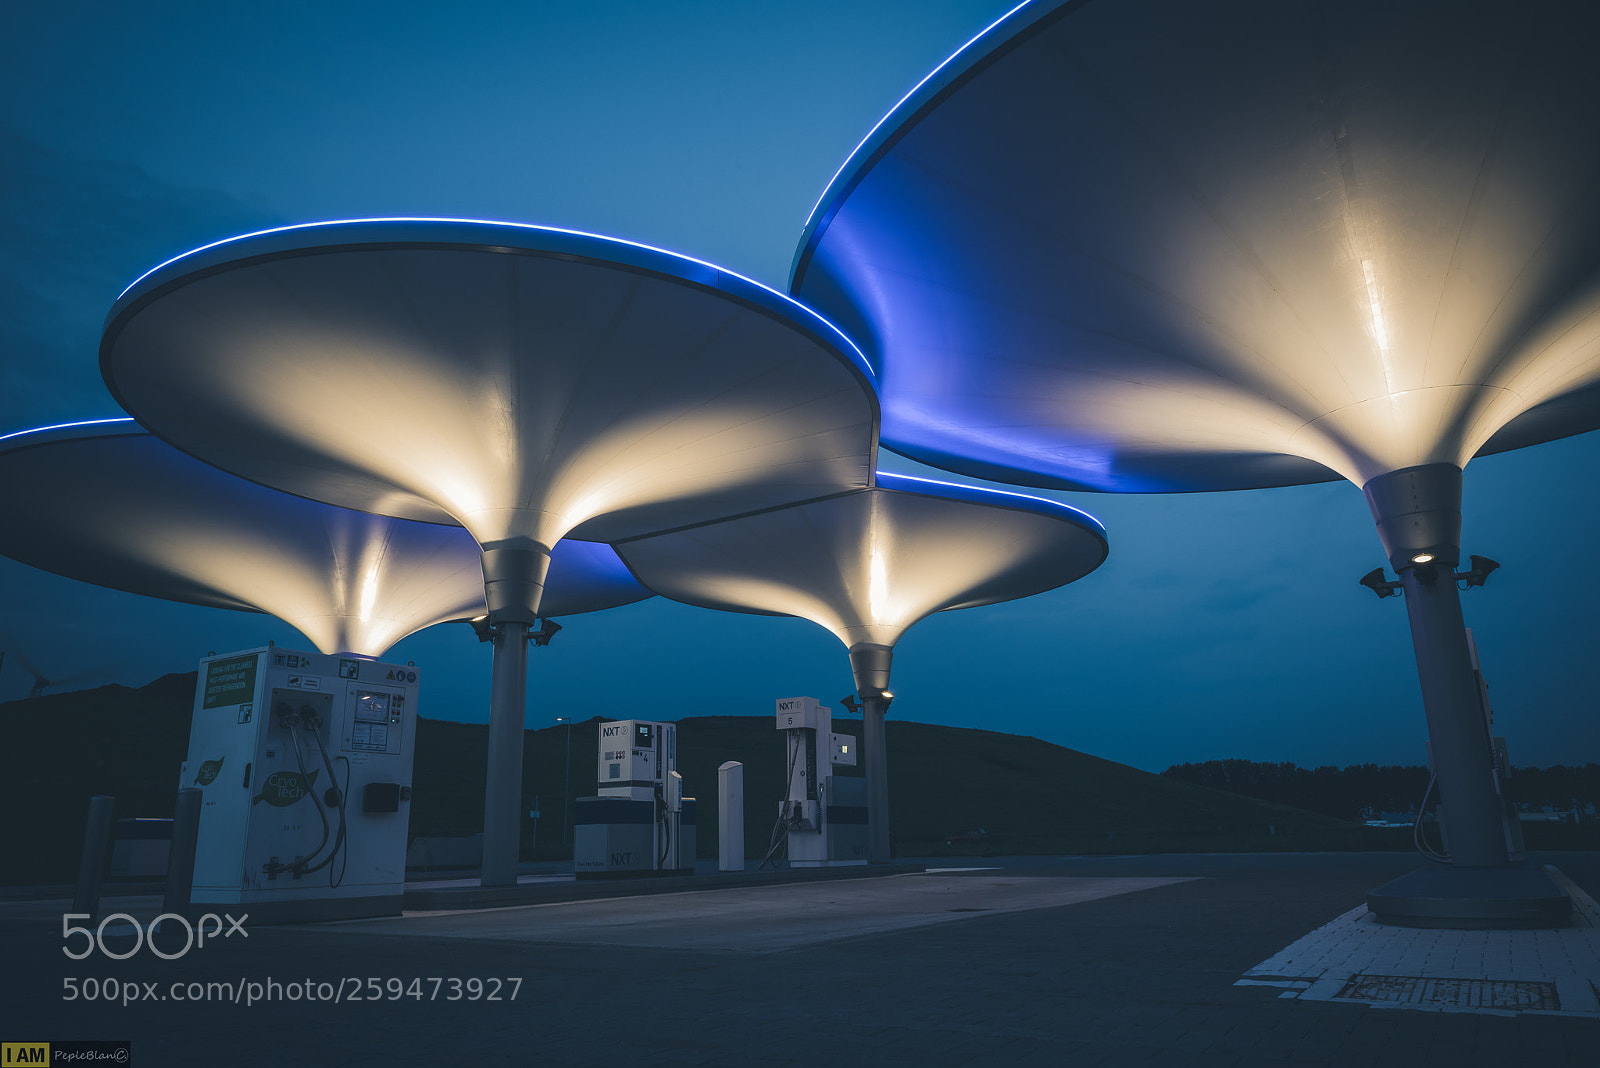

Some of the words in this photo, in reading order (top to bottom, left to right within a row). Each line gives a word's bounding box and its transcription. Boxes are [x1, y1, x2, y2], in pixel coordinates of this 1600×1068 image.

[779, 702, 794, 710] NXT
[788, 717, 793, 725] 5
[603, 726, 620, 737] NXT
[643, 753, 649, 763] 4
[269, 775, 297, 787] Cryo
[278, 786, 304, 798] Tech
[612, 852, 632, 866] NXT
